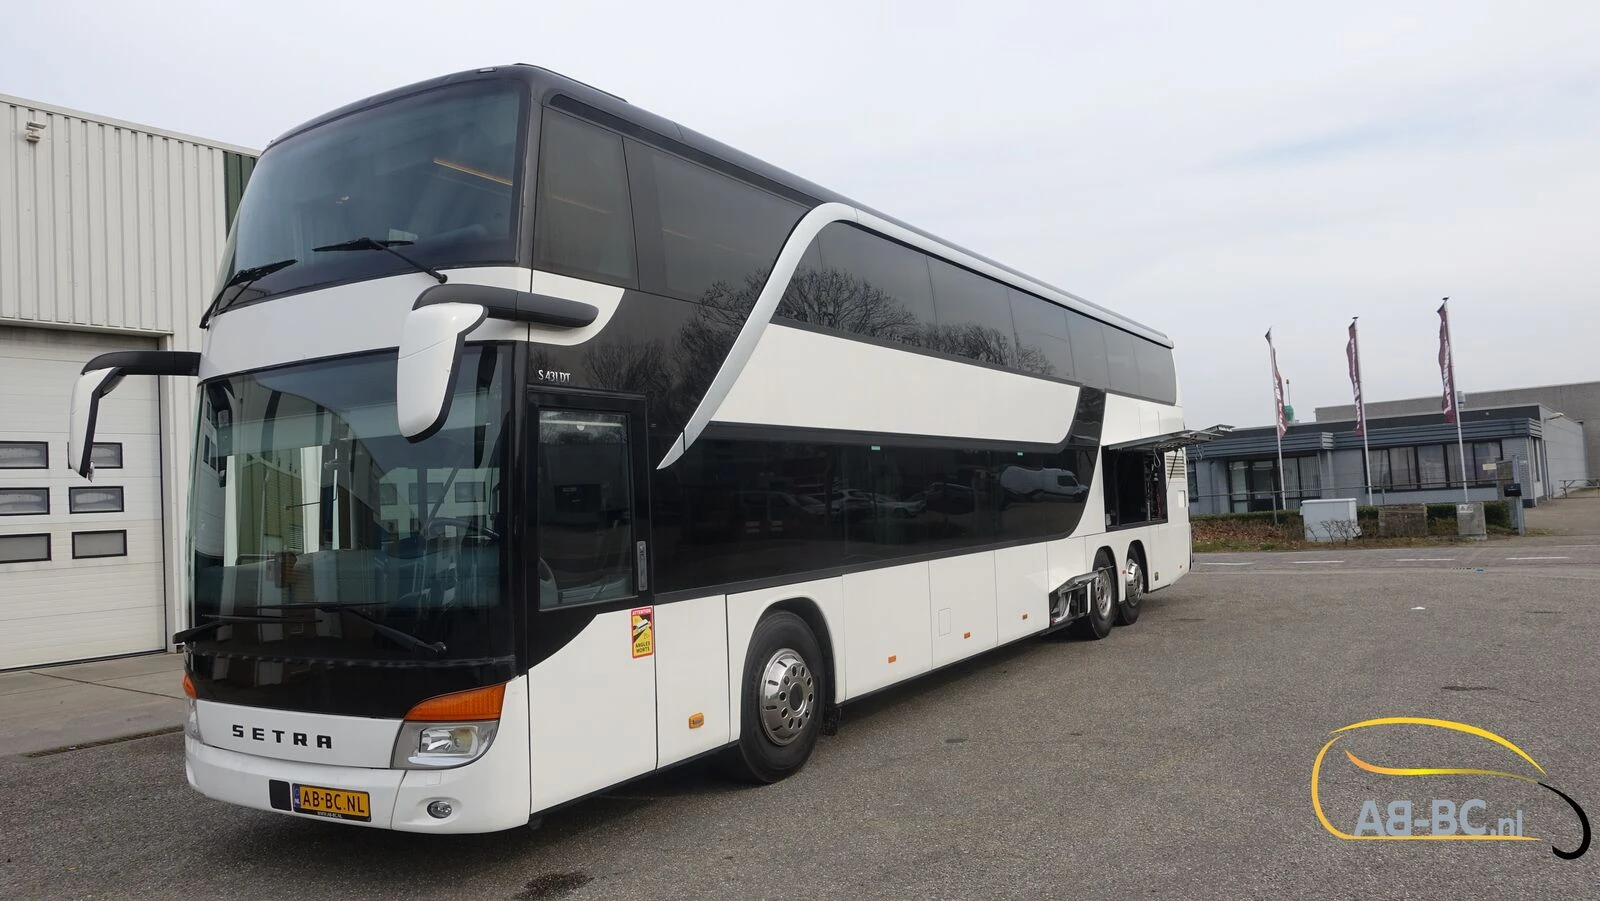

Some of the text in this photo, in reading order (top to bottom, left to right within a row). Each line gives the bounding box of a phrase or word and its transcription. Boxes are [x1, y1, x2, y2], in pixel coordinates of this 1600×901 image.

[538, 369, 571, 383] S 431 DT
[232, 724, 332, 749] SETRA
[303, 790, 365, 813] AB-BC.NL
